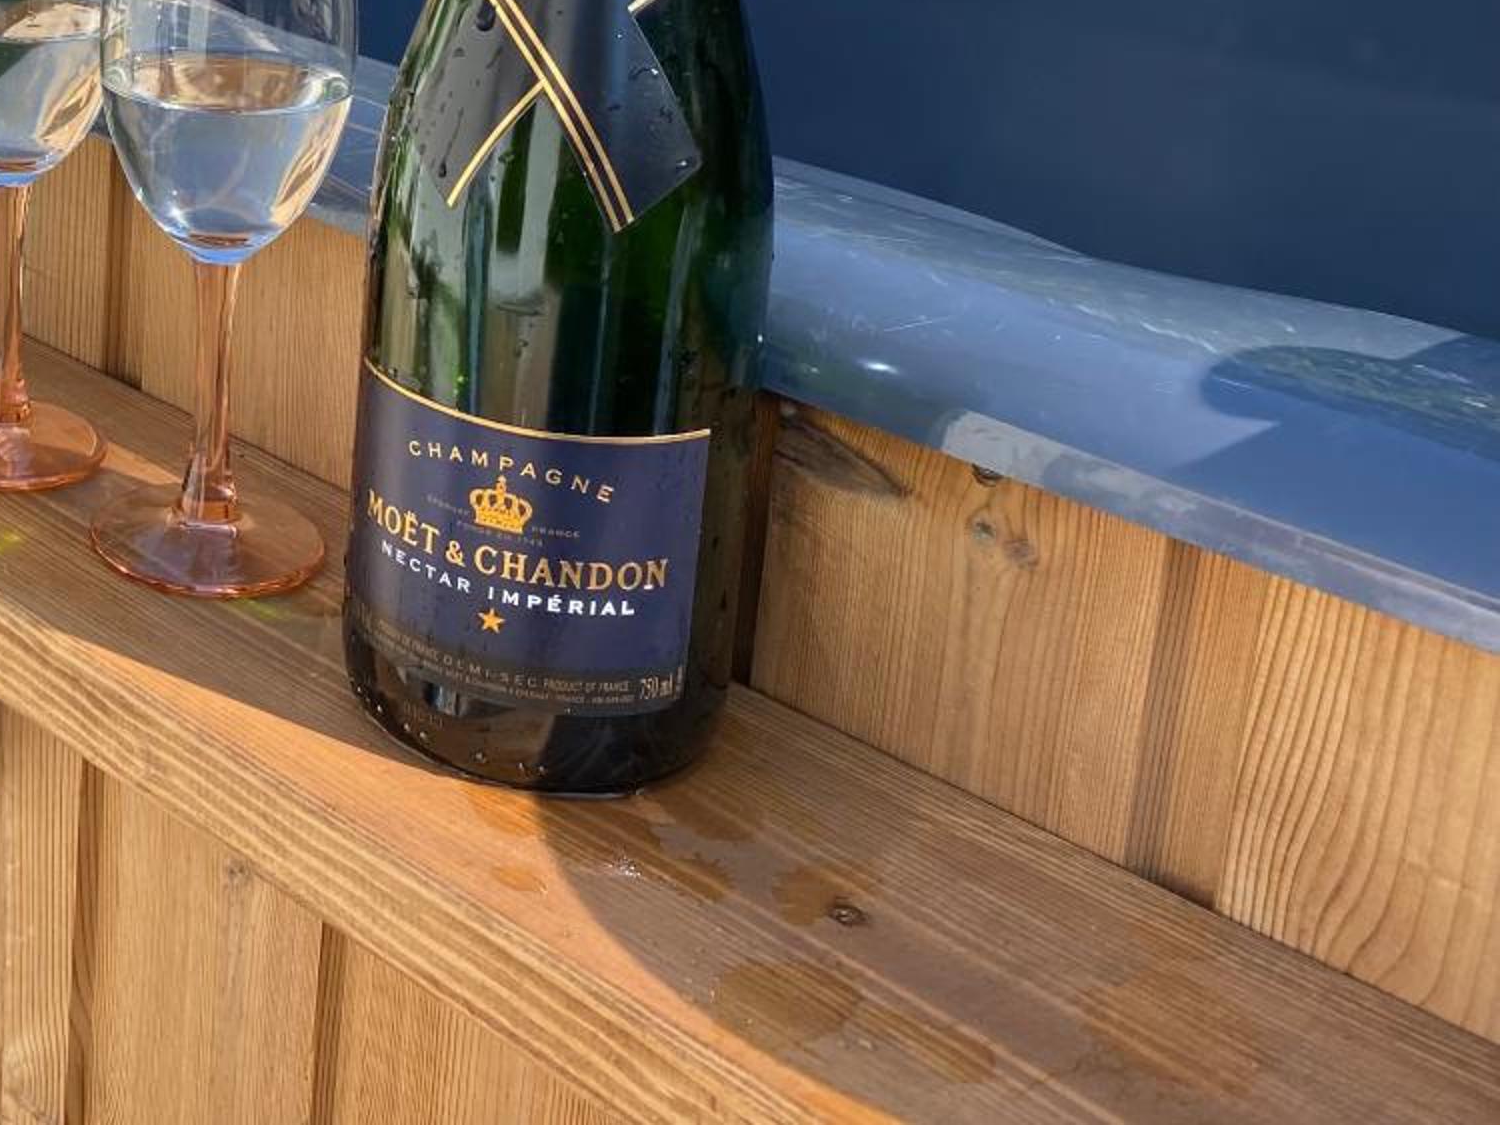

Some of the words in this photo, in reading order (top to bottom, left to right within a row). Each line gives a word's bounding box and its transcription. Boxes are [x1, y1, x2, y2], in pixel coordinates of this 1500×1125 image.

[408, 440, 615, 504] CHAMPAGNE
[366, 488, 441, 555] MOËT
[444, 540, 466, 568] &
[473, 545, 669, 591] CHANDON
[381, 540, 471, 594] NECTAR
[488, 587, 636, 617] IMPÉRIAL
